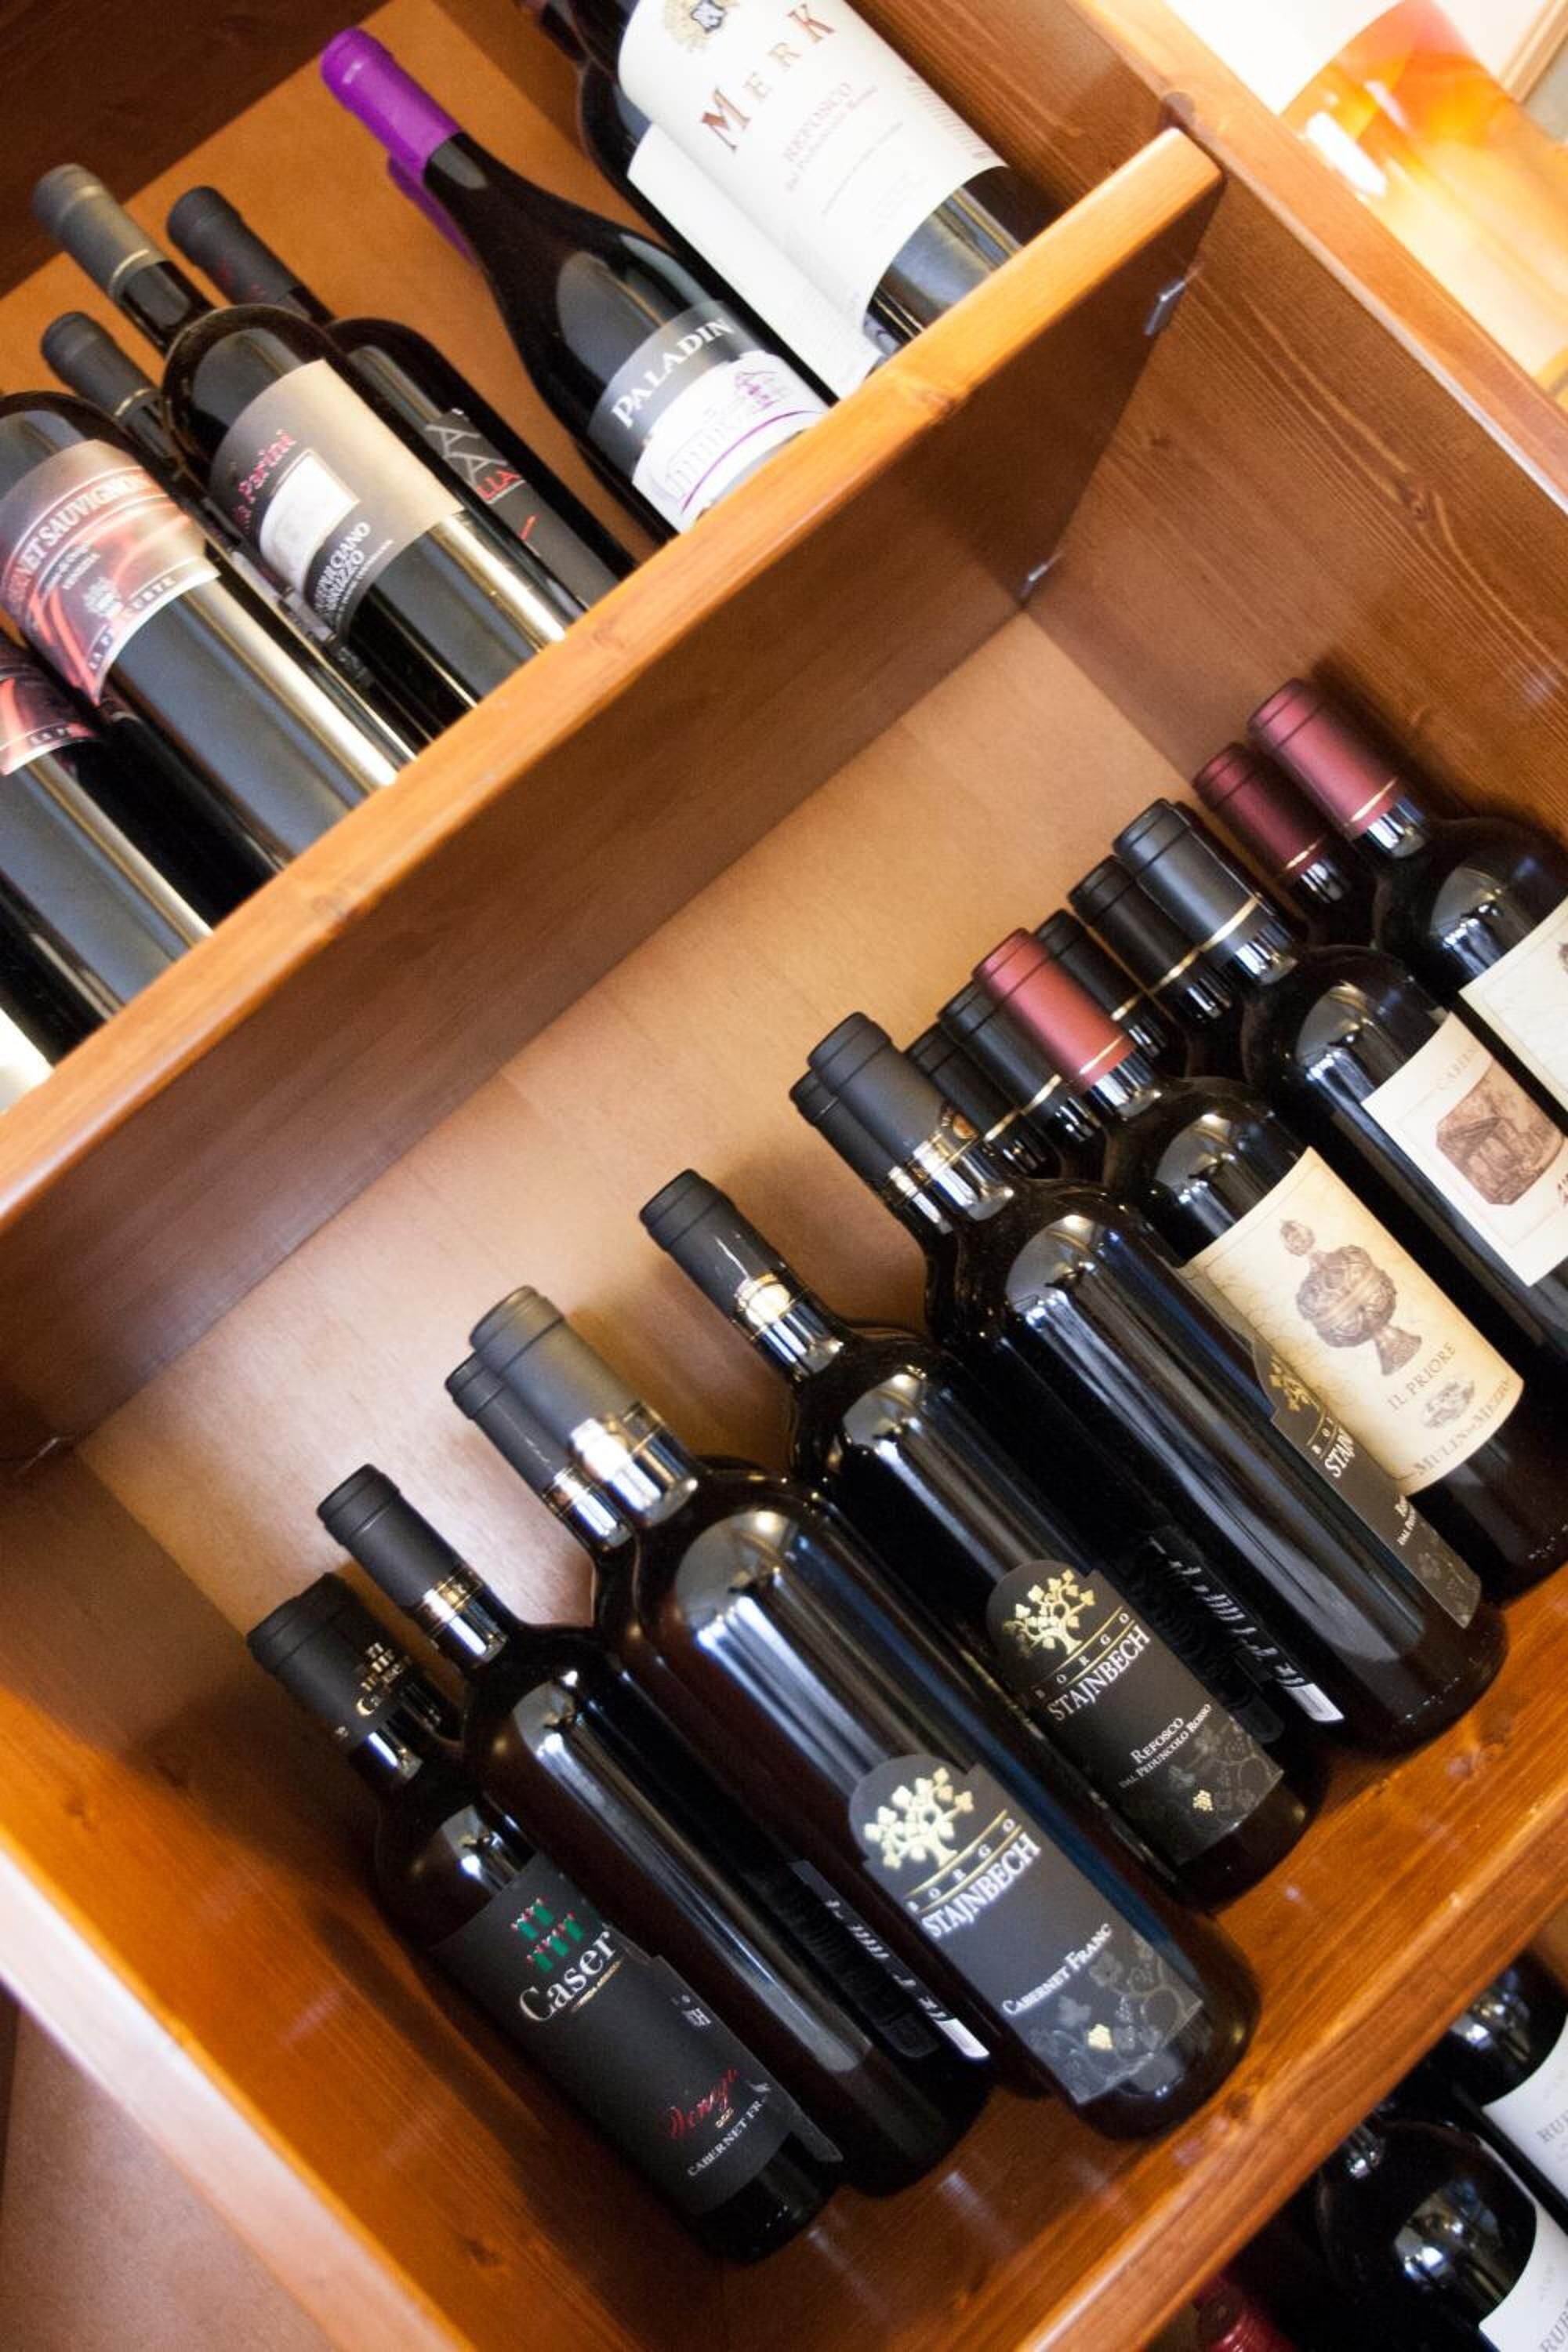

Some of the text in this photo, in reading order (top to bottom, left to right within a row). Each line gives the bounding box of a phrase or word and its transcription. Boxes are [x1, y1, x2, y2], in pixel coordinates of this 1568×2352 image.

[701, 3, 836, 153] MERK
[611, 318, 738, 429] PALADIN
[1386, 1341, 1457, 1411] IL PRIORE
[1035, 1612, 1129, 1700] BORGO
[1047, 1624, 1151, 1722] STAJNBECH
[907, 1818, 1016, 1913] BORGO
[921, 1831, 1043, 1939] STAJNBECH
[519, 1930, 617, 2022] Caser
[687, 2117, 748, 2177] CABERNET
